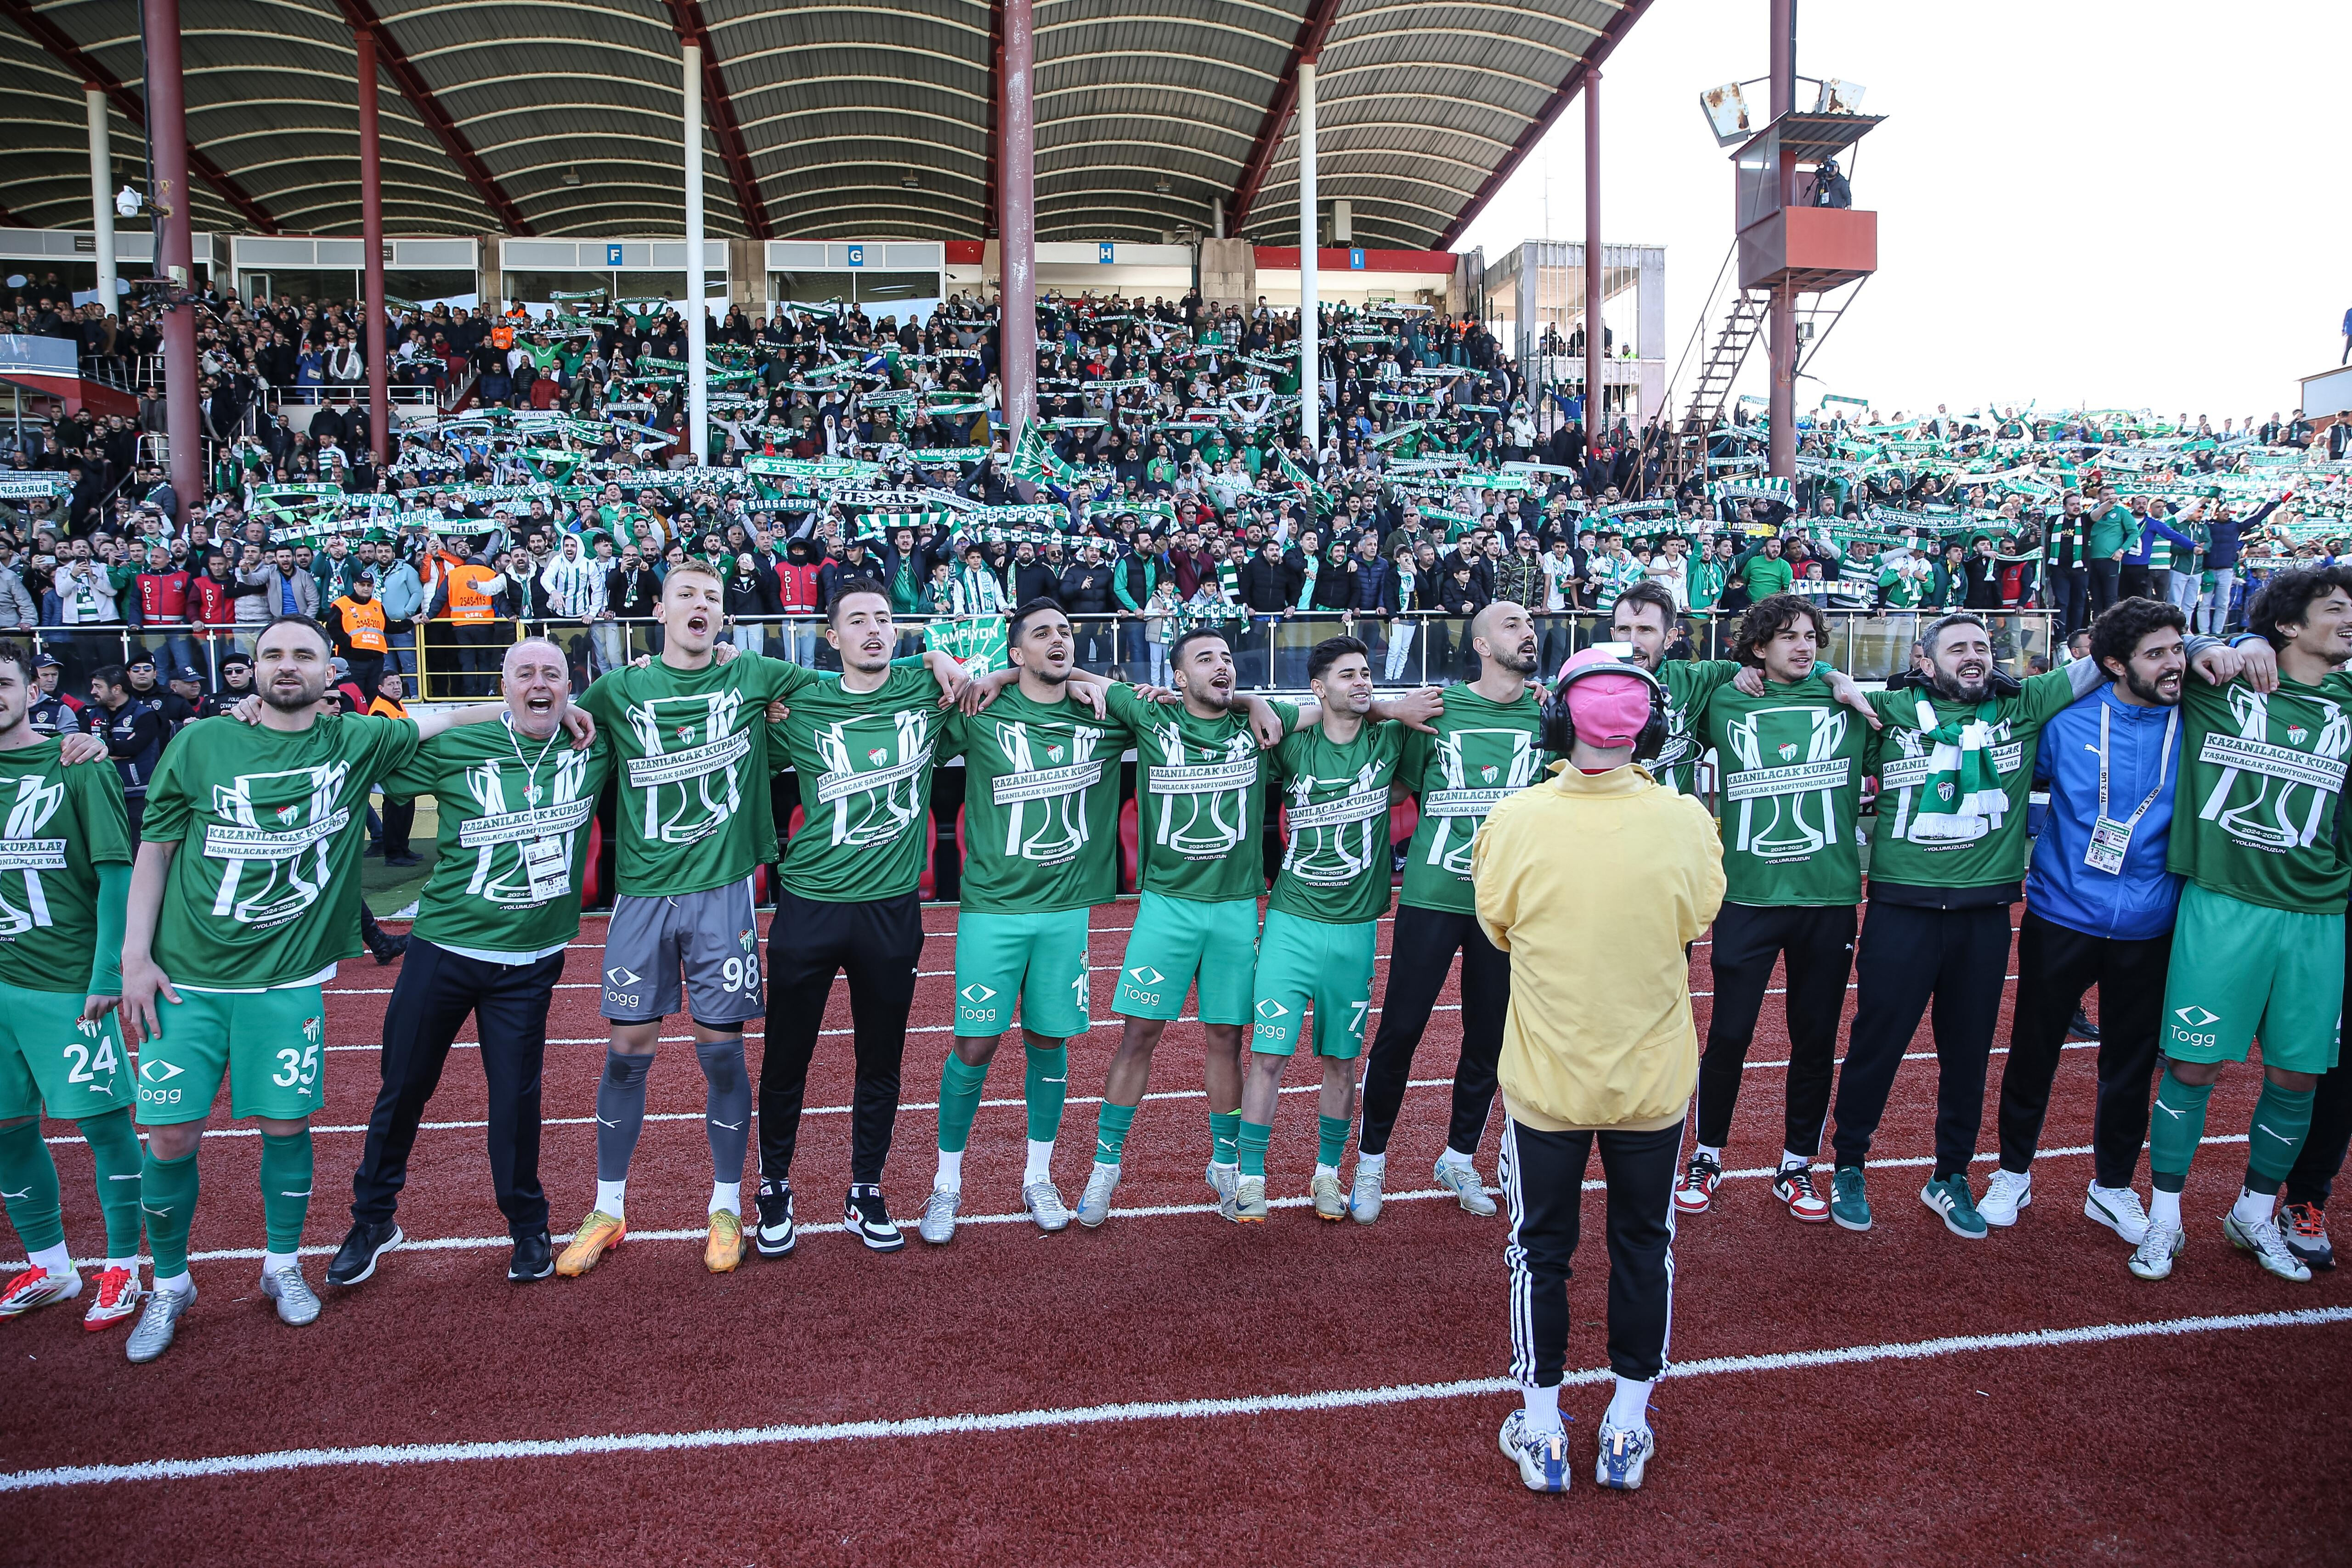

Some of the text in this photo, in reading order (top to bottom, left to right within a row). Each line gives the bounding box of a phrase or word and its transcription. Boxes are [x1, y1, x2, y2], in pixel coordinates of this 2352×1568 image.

[610, 249, 620, 260] F
[849, 250, 862, 262] G
[1102, 247, 1112, 259] H
[809, 362, 848, 376] BURSASPOR
[872, 396, 914, 406] BURSASPOR
[750, 425, 793, 435] BURSASPOR
[920, 448, 981, 457] BURSASPOR
[1885, 444, 1931, 453] Bursaspor
[661, 470, 734, 481] BURSASPOR
[772, 465, 840, 475] TEXAS
[271, 484, 327, 492] TEXAS
[816, 478, 871, 491] URSASPOR
[470, 487, 531, 502] BURSASPOR
[835, 491, 919, 504] TEXAS
[1729, 486, 1781, 499] BURSASPOR
[748, 499, 817, 510] BURSASPOR
[1106, 502, 1161, 511] TEXAS
[1607, 499, 1665, 513] BURSASPOR
[959, 510, 1046, 526] BURSASPOR
[1427, 506, 1481, 524] BURSASPO
[1883, 514, 1958, 525] BURSASPOR
[1619, 518, 1673, 534] BURSASPOR
[1833, 530, 1868, 539] YENİDEN
[460, 596, 486, 606] 2548-115
[932, 627, 998, 649] ŞAMPİYON
[2207, 735, 2304, 764] KAZANILACAK
[629, 750, 702, 771] KAZANILACAK
[1884, 759, 1928, 774] KAZANIL
[1151, 768, 1220, 777] KAZANILACAK
[1728, 760, 1848, 785] KAZANILACAK KUPALAR
[2204, 751, 2335, 787] YAŞANILACAK ŞAMPİYONLUKLAR
[633, 773, 673, 784] YAŞANILACAK
[994, 770, 1069, 788] KAZANILACAK
[1191, 777, 1250, 790] ŞAMPİYONLUKLAR
[820, 781, 863, 799] YAŞANILACAK
[1729, 787, 1769, 798] YAŞANILACAK
[1771, 778, 1835, 792] ŞAMPİYONLUKLAR
[995, 789, 1040, 801] YAŞANILACAK
[1430, 791, 1500, 802] KAZANILACAK
[1315, 807, 1376, 824] ŞAMPİYONLUKLAR
[2135, 804, 2146, 816] TFF
[2099, 822, 2124, 833] Delegasyon
[2242, 827, 2281, 840] 2024-2025
[209, 827, 304, 842] KAZANILACAK
[464, 832, 514, 844] YAŞANILACAK
[0, 842, 62, 850] KUPALAR
[208, 845, 268, 855] YAŞANILACAK
[1923, 843, 1974, 851] #YOLUMUZUZUN
[2094, 843, 2120, 855] Bursaspor
[2232, 839, 2286, 854] #YOLUMUZUZUN
[1765, 856, 1810, 864] #YOLUMUZUZUN
[722, 954, 760, 993] 98
[605, 986, 640, 1008] Togg
[1123, 983, 1161, 1007] Togg
[960, 1006, 996, 1022] Togg
[1348, 1001, 1369, 1032] 7
[1254, 1020, 1286, 1040] Togg
[2171, 1025, 2216, 1047] Togg
[63, 1036, 119, 1084] 24
[272, 1043, 319, 1087] 35
[138, 1084, 182, 1104] Togg
